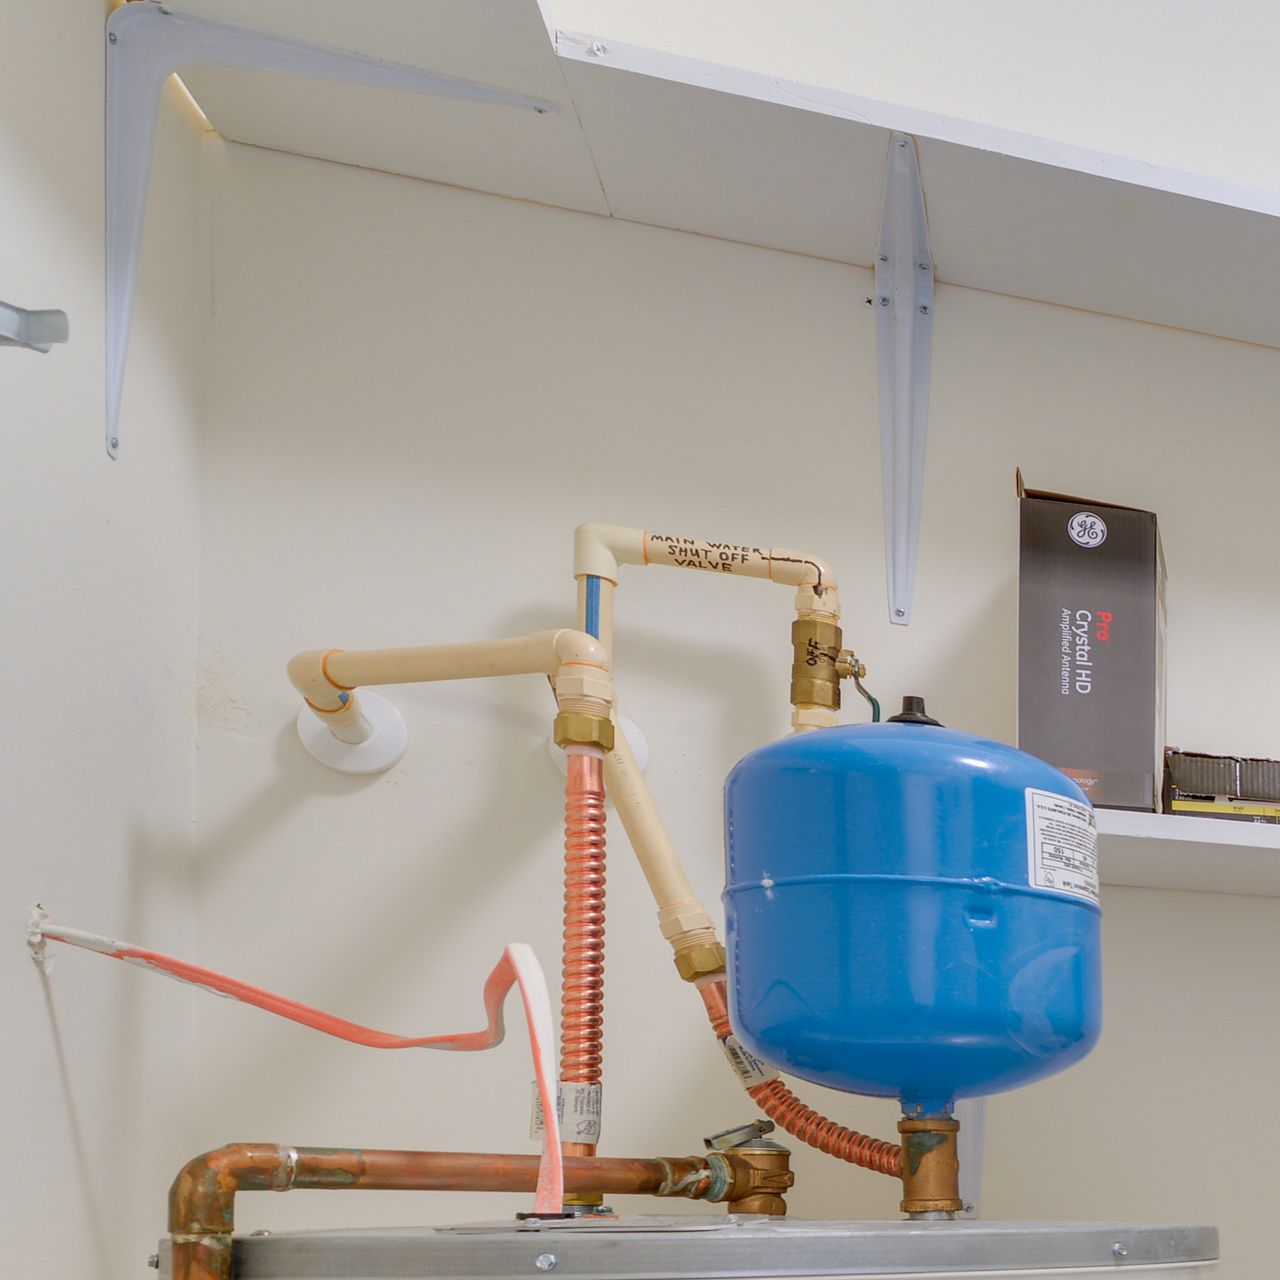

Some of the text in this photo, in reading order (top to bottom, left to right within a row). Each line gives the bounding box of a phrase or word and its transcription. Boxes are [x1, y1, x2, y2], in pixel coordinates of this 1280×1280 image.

[650, 534, 764, 556] MAIN WATER
[668, 545, 750, 564] SHUT OFF
[674, 559, 733, 572] VALVE
[1096, 610, 1113, 641] Pro
[1061, 608, 1072, 695] Amplified Antenna
[1076, 610, 1092, 694] Crystal HD
